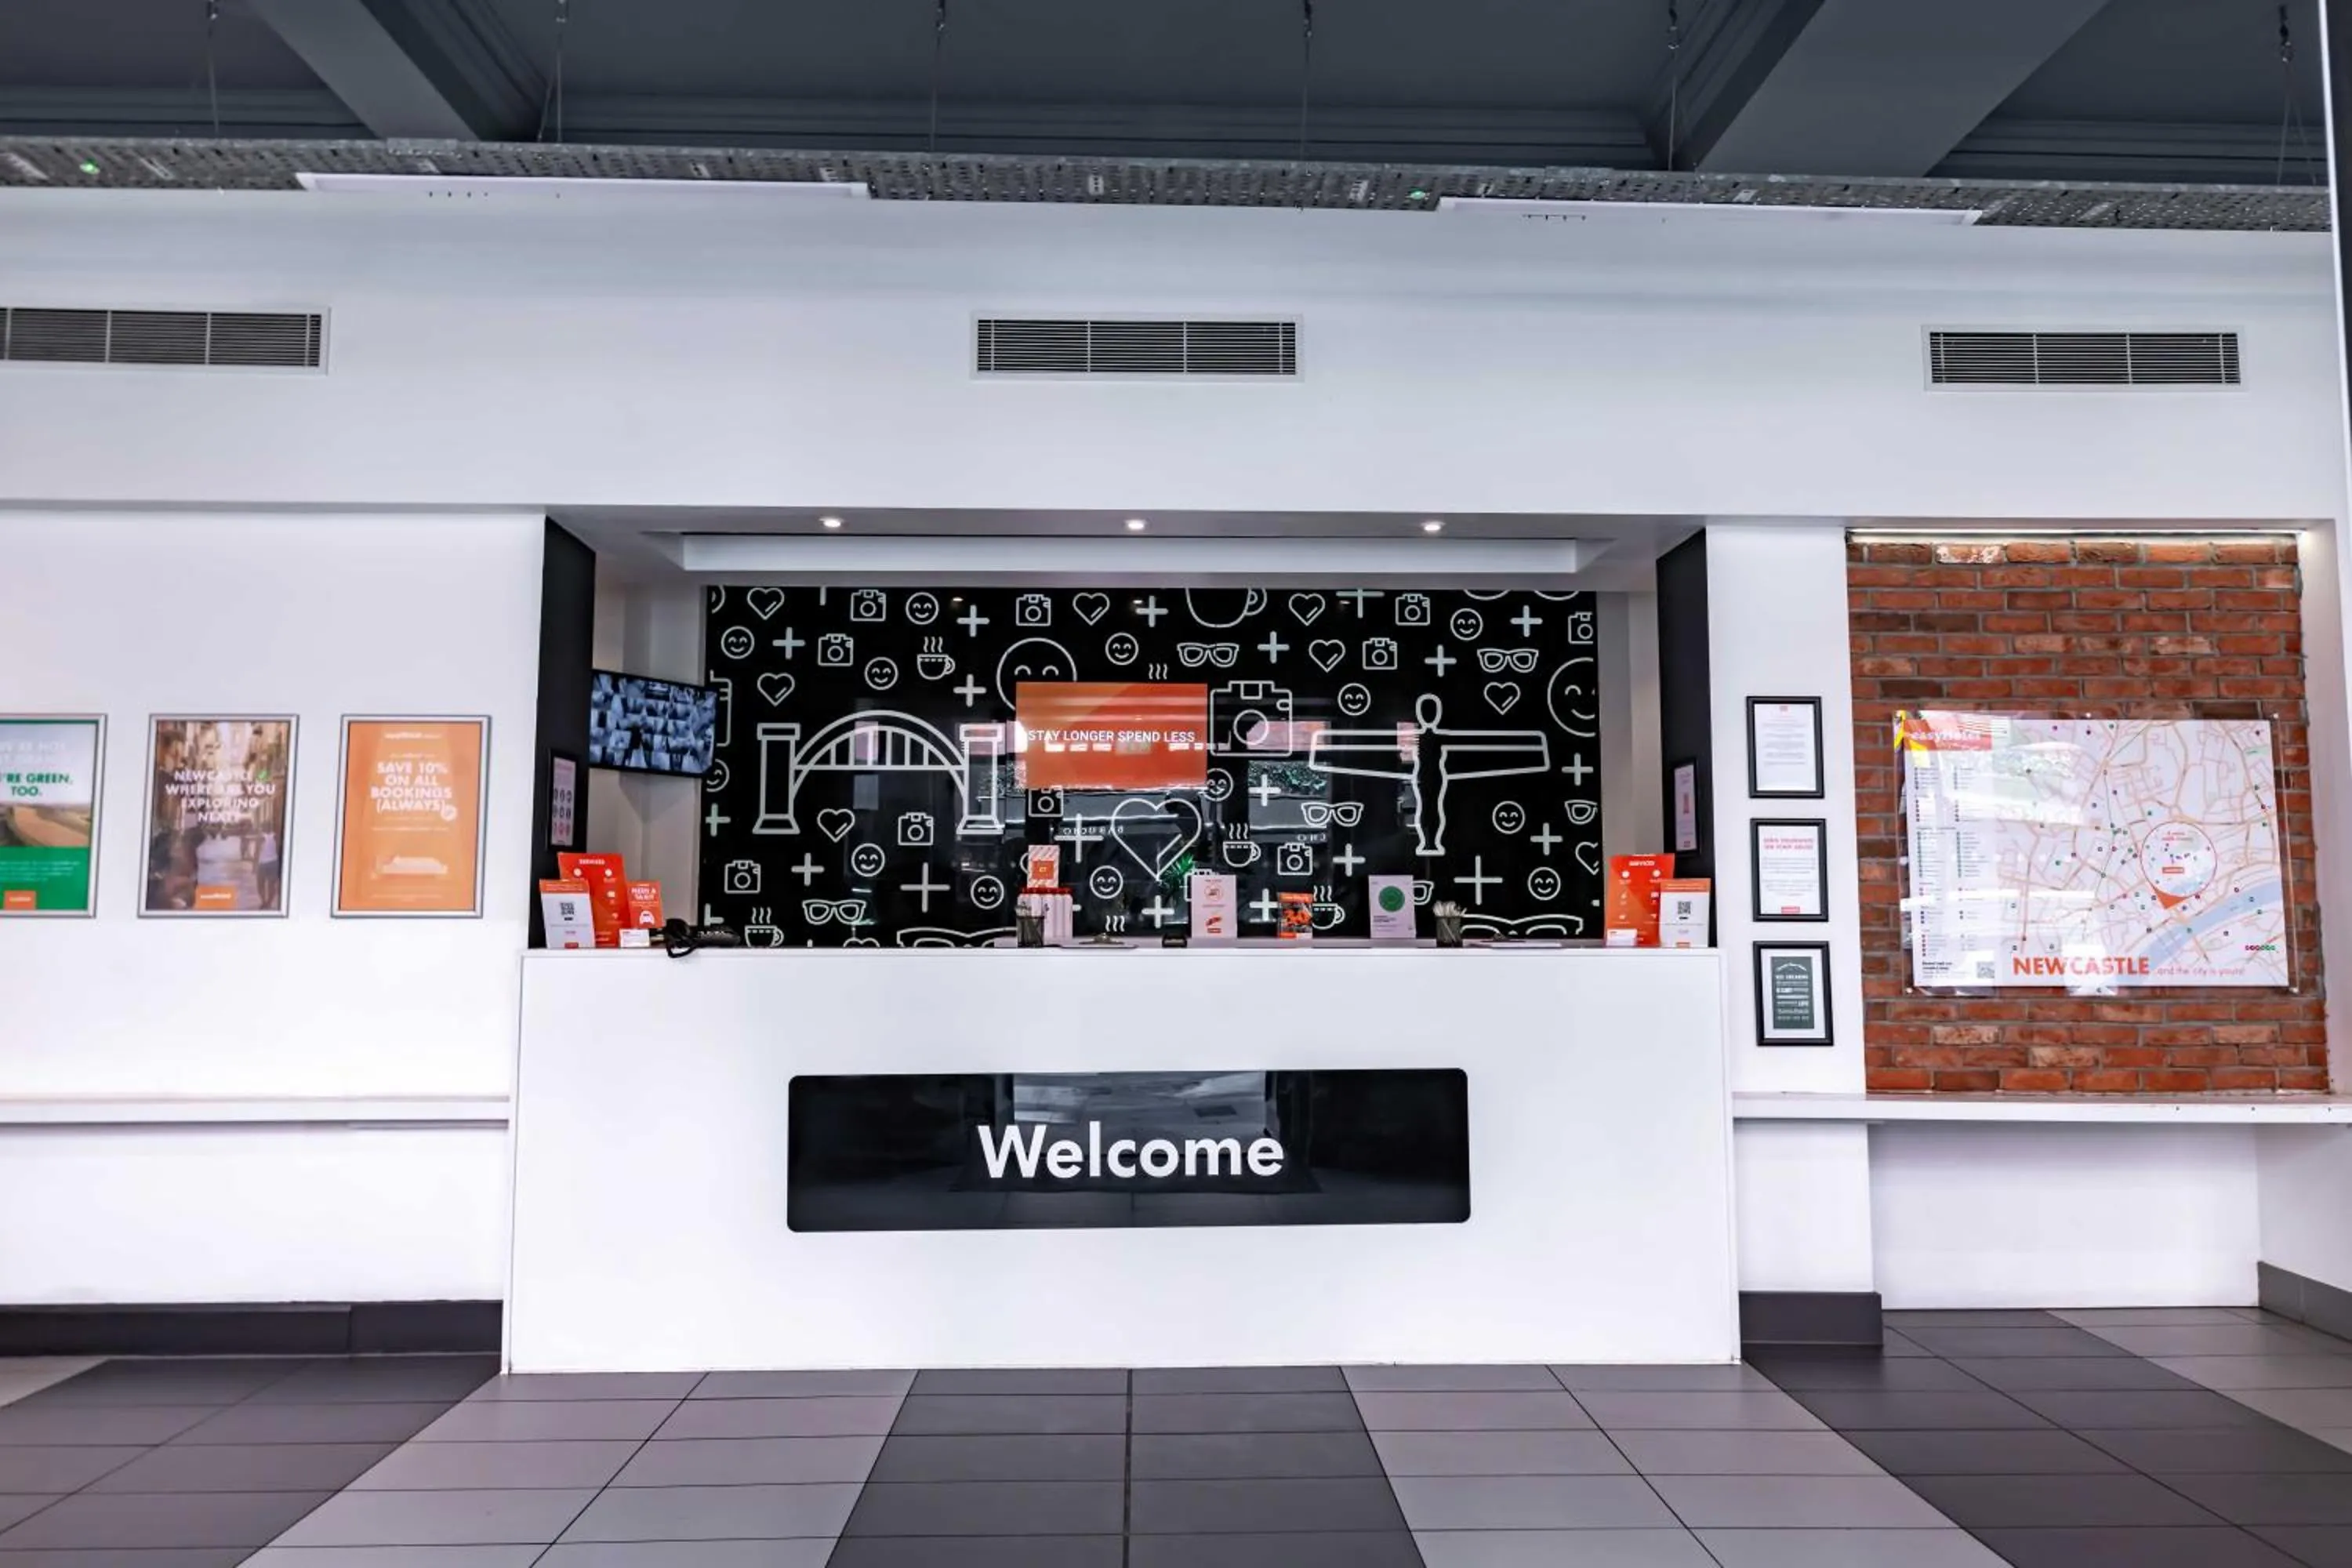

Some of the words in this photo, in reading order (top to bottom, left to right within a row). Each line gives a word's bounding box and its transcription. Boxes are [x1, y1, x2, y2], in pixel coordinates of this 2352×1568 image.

[1028, 731, 1060, 742] STAY
[1063, 731, 1114, 742] LONGER
[1117, 731, 1160, 742] SPEND
[1163, 732, 1196, 743] LESS
[377, 762, 412, 774] SAVE
[418, 762, 448, 774] 10%
[385, 775, 409, 786] ON
[415, 775, 438, 786] ALL
[11, 786, 42, 797] TOO.
[246, 784, 276, 796] YOU
[371, 786, 452, 800] BOOKINGS
[2013, 956, 2150, 976] NEWCASTLE
[977, 1120, 1285, 1178] Welcome
